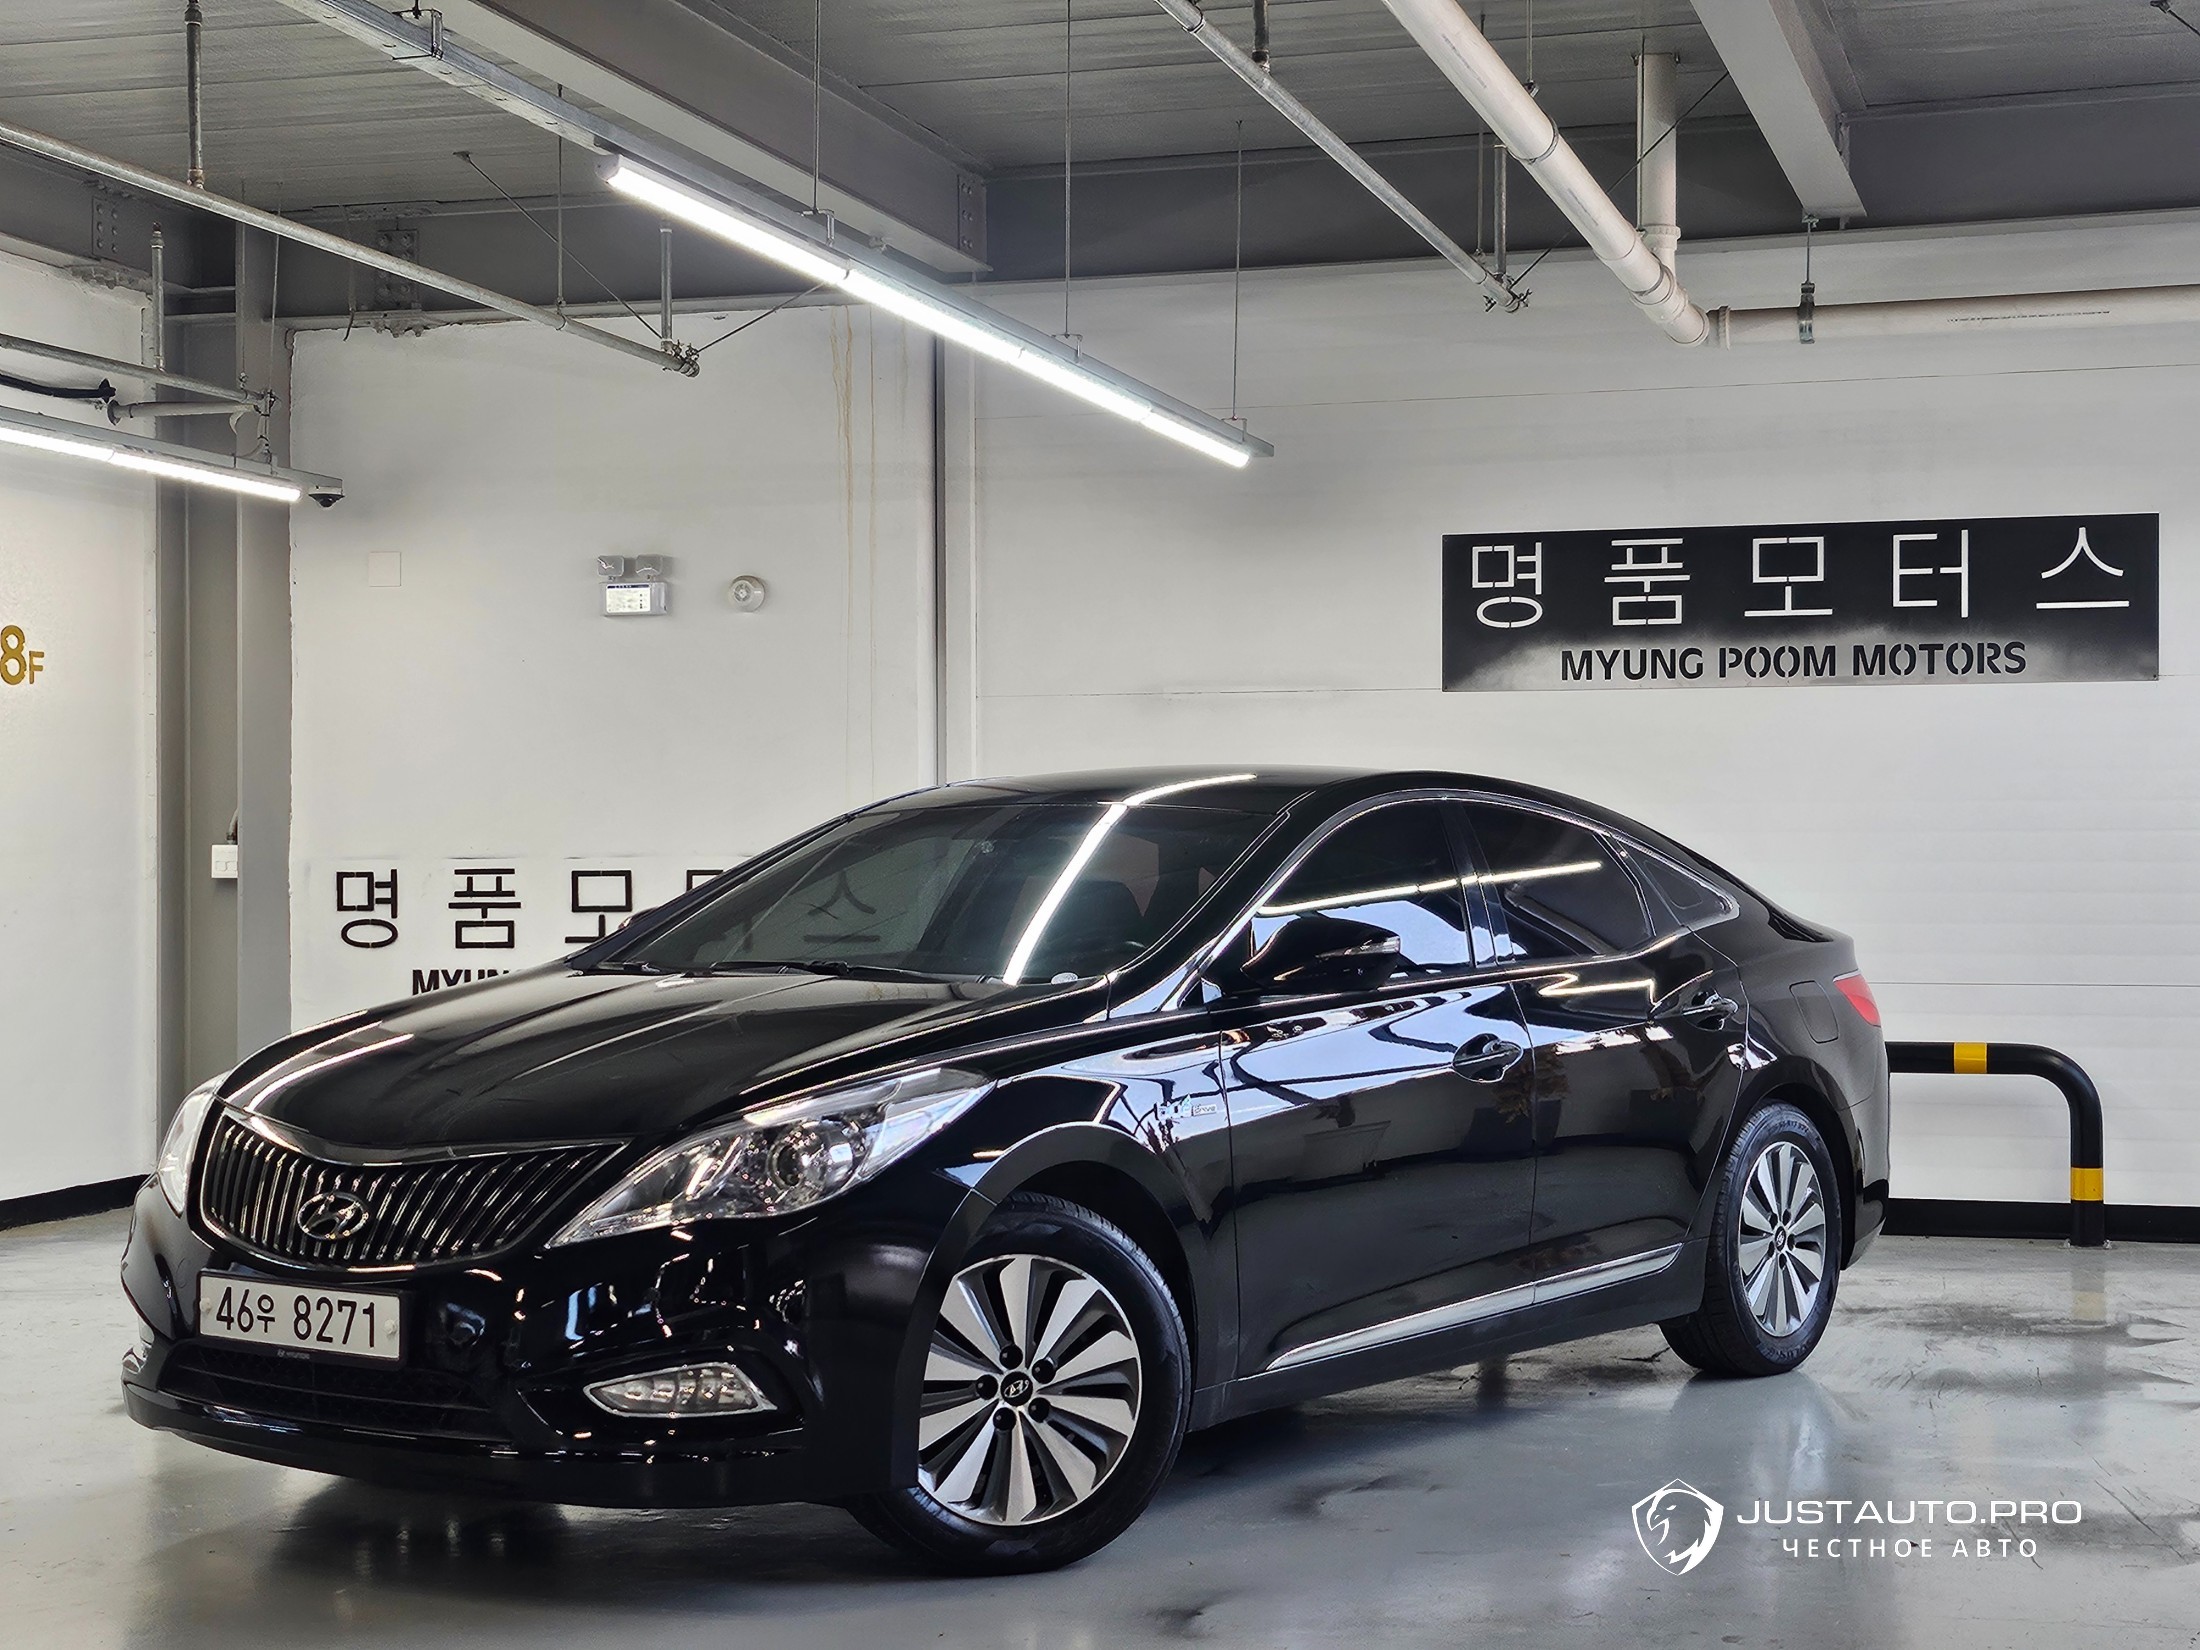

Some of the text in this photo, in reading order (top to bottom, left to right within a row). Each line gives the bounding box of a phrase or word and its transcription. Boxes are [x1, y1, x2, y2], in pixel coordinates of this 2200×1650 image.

[1471, 526, 2131, 629] 명품모터스
[0, 624, 45, 686] 8F
[1560, 641, 2027, 681] MYUNG POOM MOTORS
[216, 1286, 375, 1348] 46우 8271
